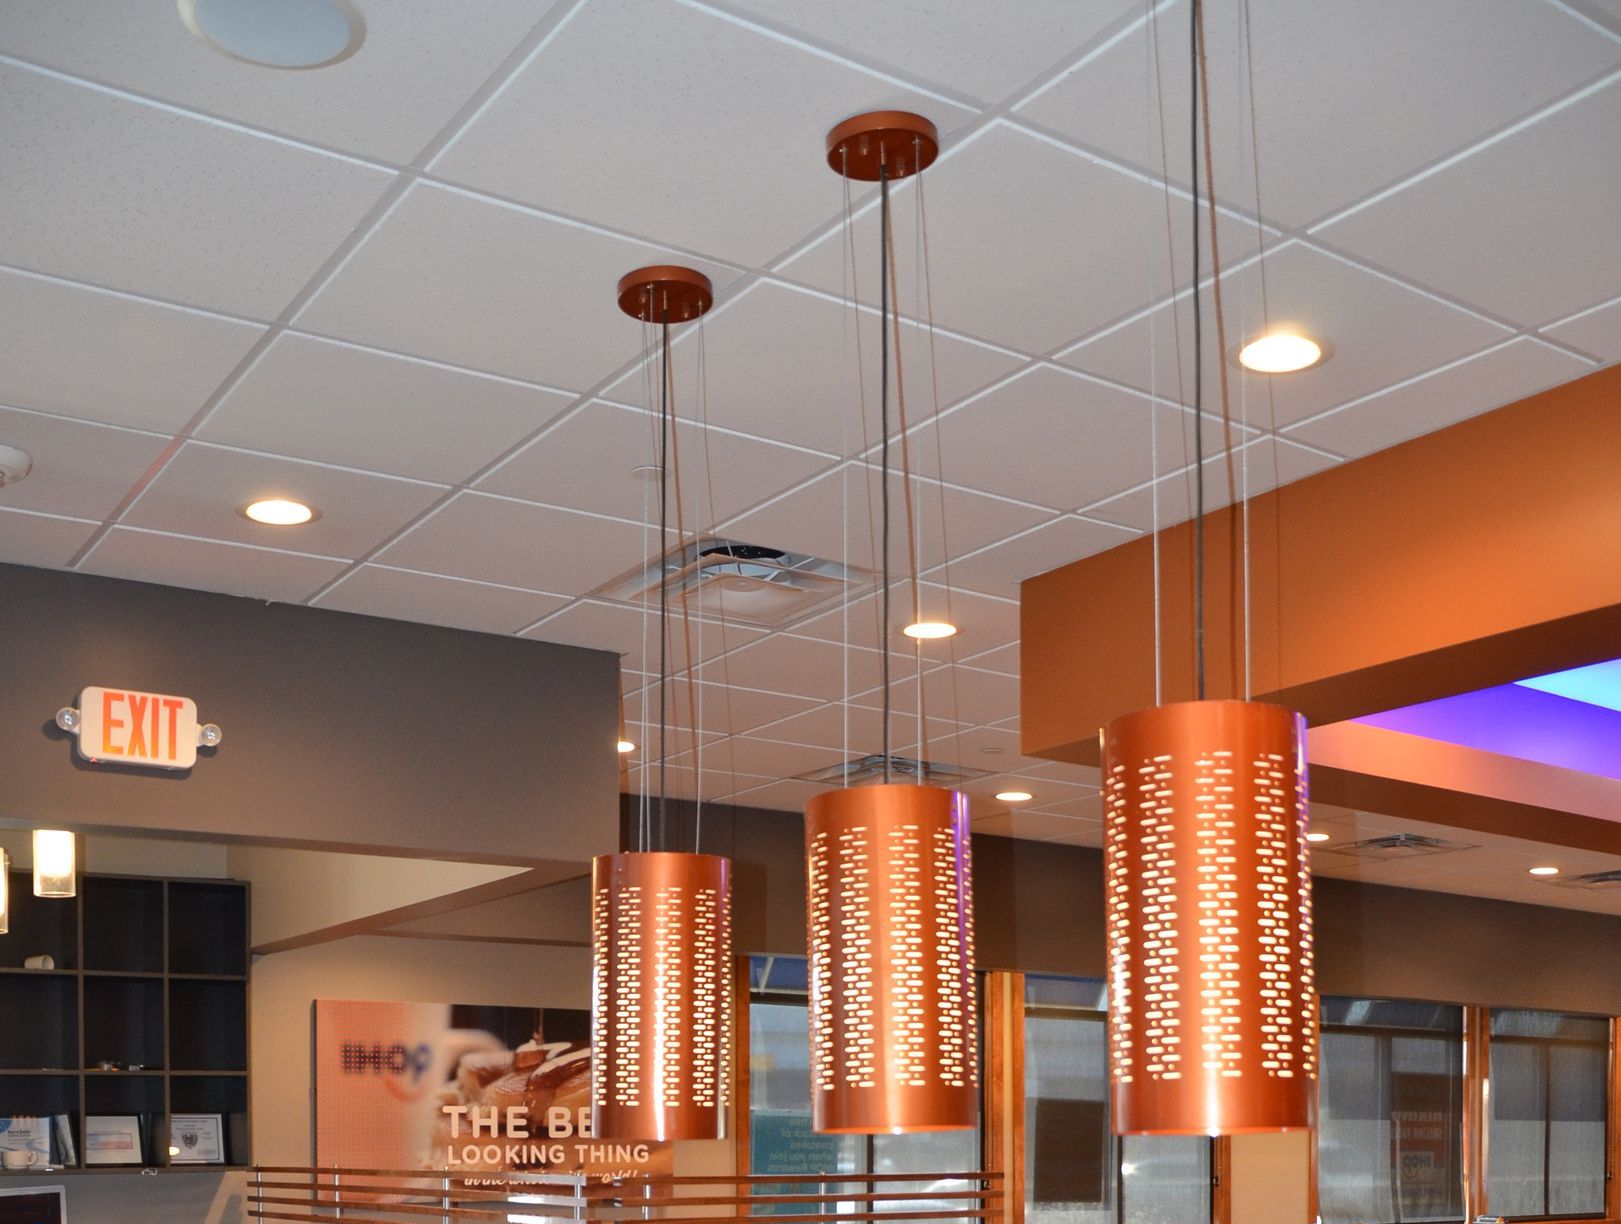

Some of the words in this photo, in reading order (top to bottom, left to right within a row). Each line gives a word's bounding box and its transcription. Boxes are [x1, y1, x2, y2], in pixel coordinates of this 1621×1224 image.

[102, 691, 183, 760] EXIT
[442, 1106, 530, 1139] THE
[548, 1106, 591, 1139] BE
[448, 1145, 565, 1165] LOOKING
[574, 1144, 649, 1164] THING
